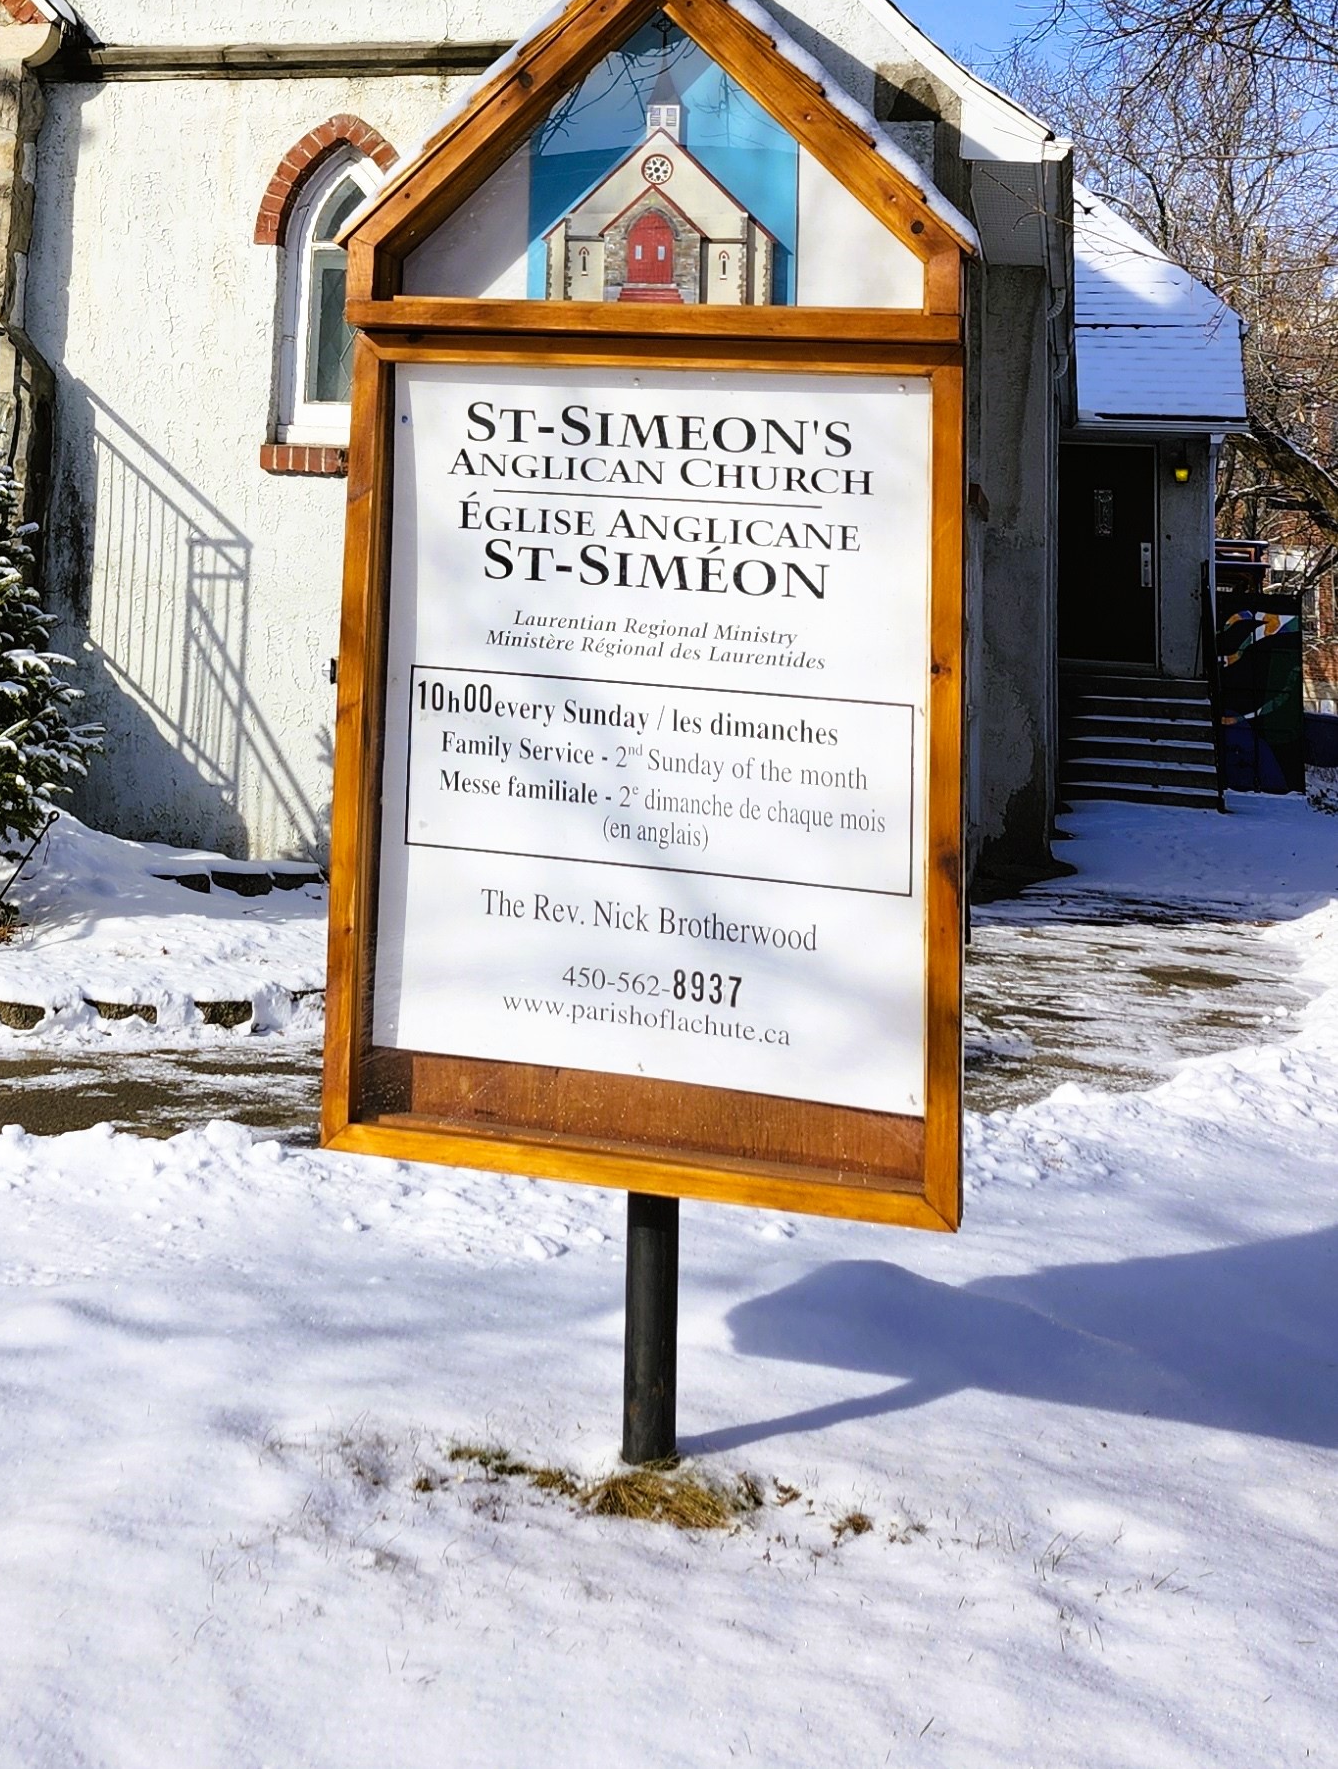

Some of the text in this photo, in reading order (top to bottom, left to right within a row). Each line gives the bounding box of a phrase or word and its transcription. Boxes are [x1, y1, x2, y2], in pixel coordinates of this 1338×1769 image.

[485, 629, 825, 670] Ministère Régional des Laurentides
[512, 609, 798, 649] Laurentian Regional Ministry
[563, 698, 648, 736] Sunday
[672, 708, 702, 735] les
[710, 711, 838, 746] dimanches
[441, 730, 513, 764] Family
[519, 737, 594, 765] Service
[647, 748, 725, 783] Sunday
[731, 757, 754, 780] of
[760, 758, 792, 783] the
[800, 766, 868, 791] month
[440, 768, 501, 796] Messe
[507, 775, 598, 806] familiale
[644, 788, 733, 818] dimanche
[739, 797, 761, 821] de
[767, 800, 834, 833] chaque
[840, 812, 886, 833] mois
[602, 815, 709, 852] (en anglais)
[480, 888, 817, 952] The Rev. Nick Brotherwood
[561, 965, 743, 1009] 450-562-8937
[503, 993, 791, 1048] www.parishoflachute.ca
